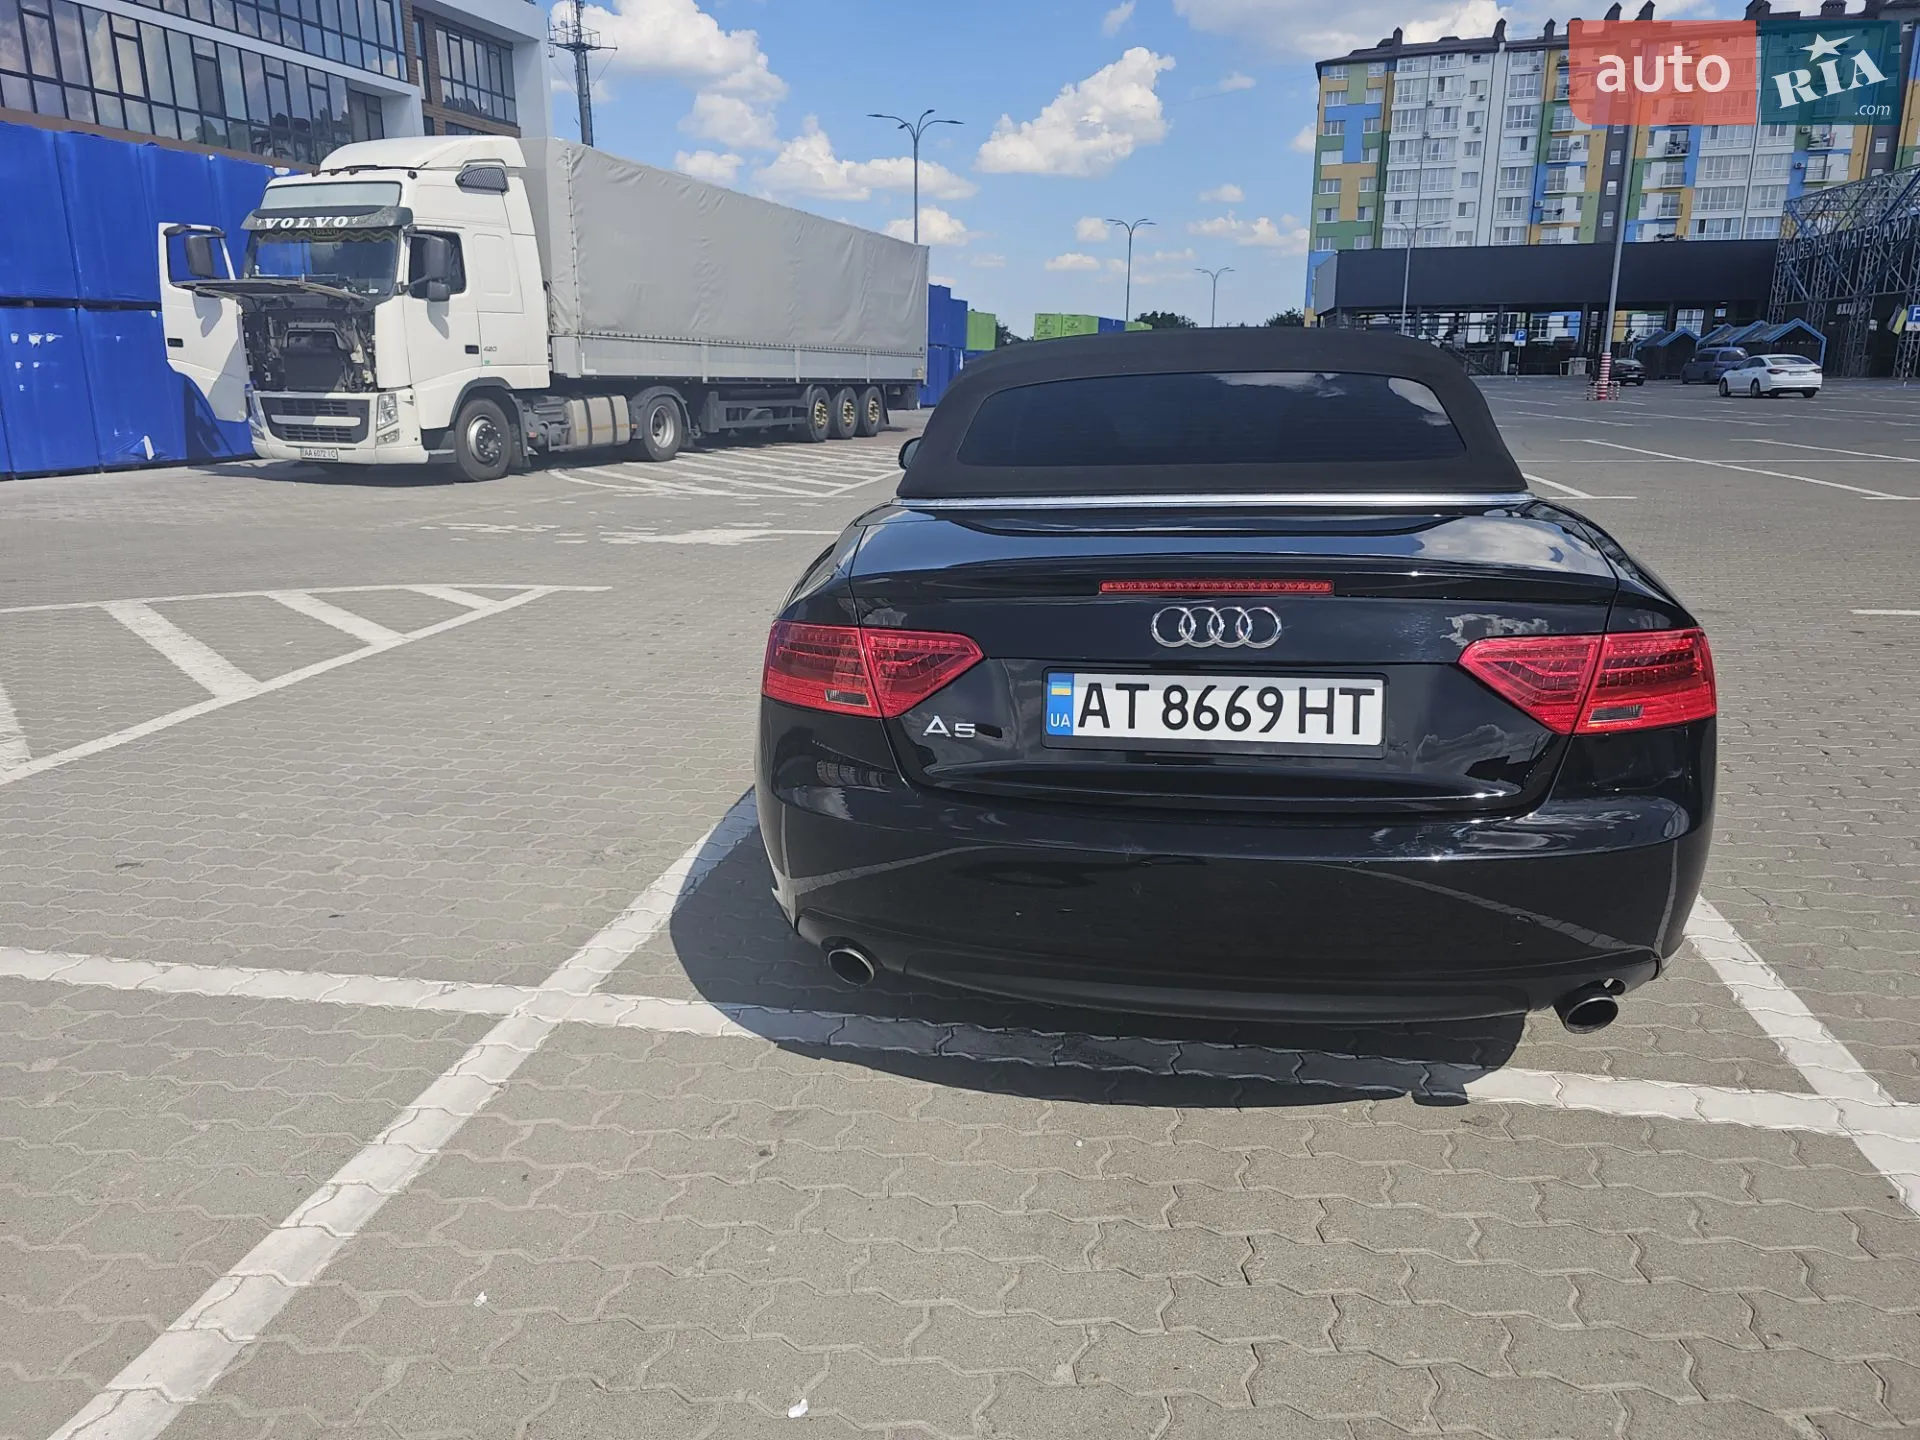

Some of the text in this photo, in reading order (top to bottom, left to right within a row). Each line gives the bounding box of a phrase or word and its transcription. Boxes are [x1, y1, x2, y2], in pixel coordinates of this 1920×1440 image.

[264, 216, 349, 229] VOLVO
[1077, 682, 1376, 736] AT 8669 HT
[922, 715, 976, 738] A5
[1050, 713, 1071, 728] UA
